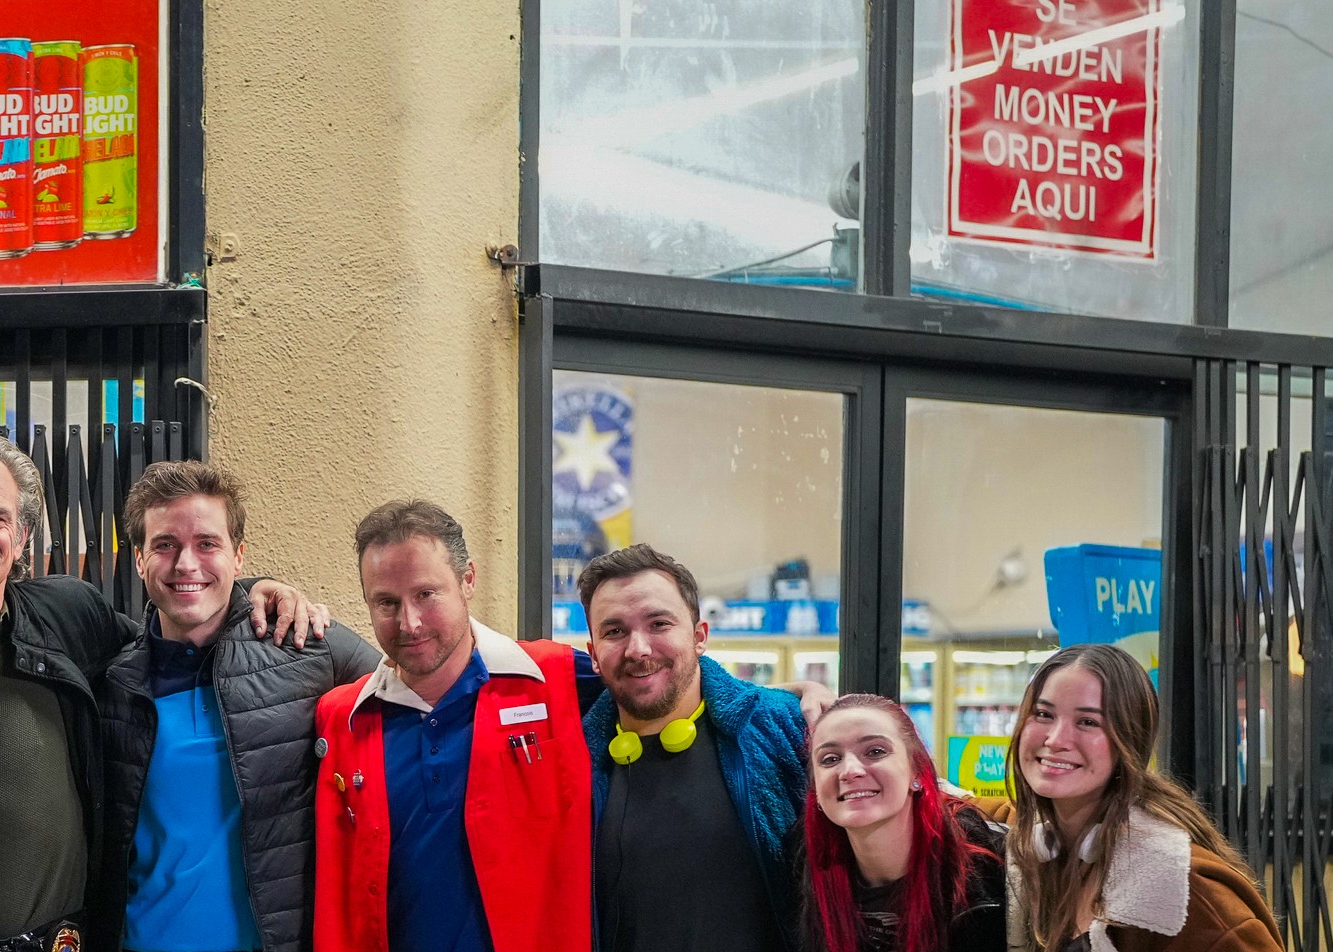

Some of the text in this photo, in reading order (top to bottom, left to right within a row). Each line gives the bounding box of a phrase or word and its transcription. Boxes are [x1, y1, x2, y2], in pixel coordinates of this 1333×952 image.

[1036, 0, 1077, 25] SE
[988, 29, 1123, 84] VENDEN
[994, 83, 1117, 133] MONEY
[983, 130, 1124, 181] ORDERS
[1010, 178, 1096, 221] AQUI
[1095, 577, 1155, 615] PLAY
